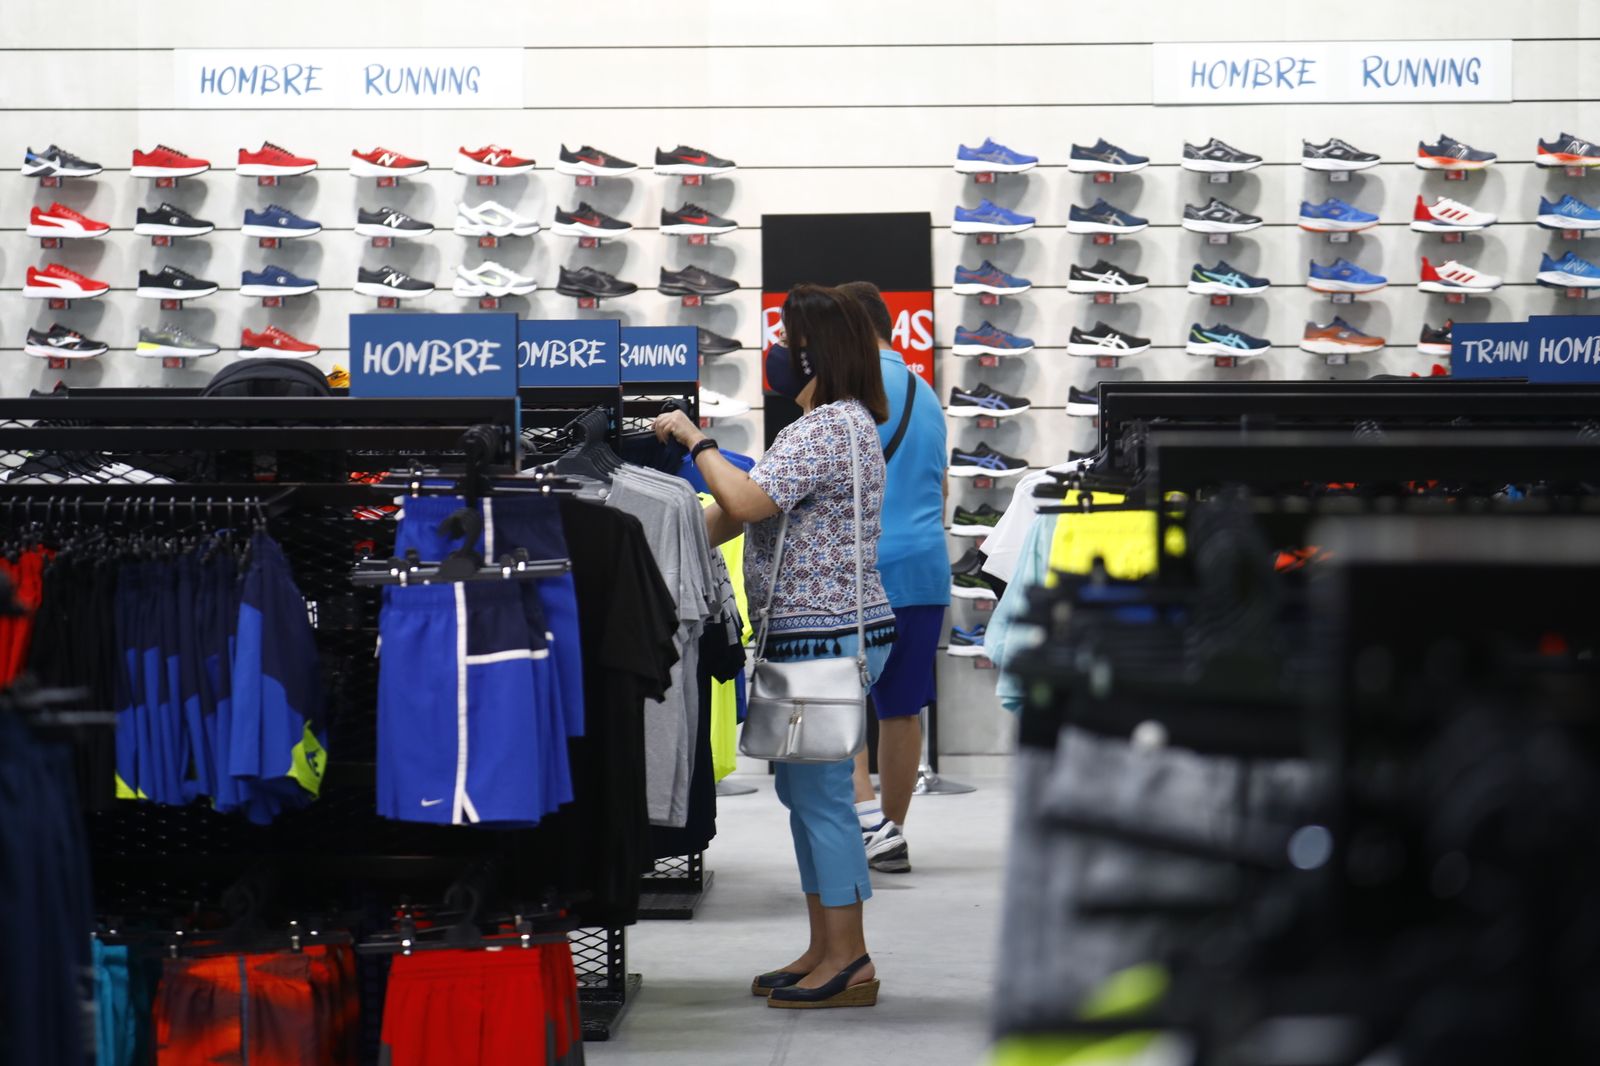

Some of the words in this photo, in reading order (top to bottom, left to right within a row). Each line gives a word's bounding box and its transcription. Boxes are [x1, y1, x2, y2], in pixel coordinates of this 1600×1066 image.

[200, 64, 323, 96] HOMBRE
[363, 64, 481, 96] RUNNING
[1191, 57, 1317, 90] HOMBRE
[1362, 55, 1481, 89] RUNNING
[363, 338, 502, 377] HOMBRE
[1460, 339, 1529, 364] TRAINI
